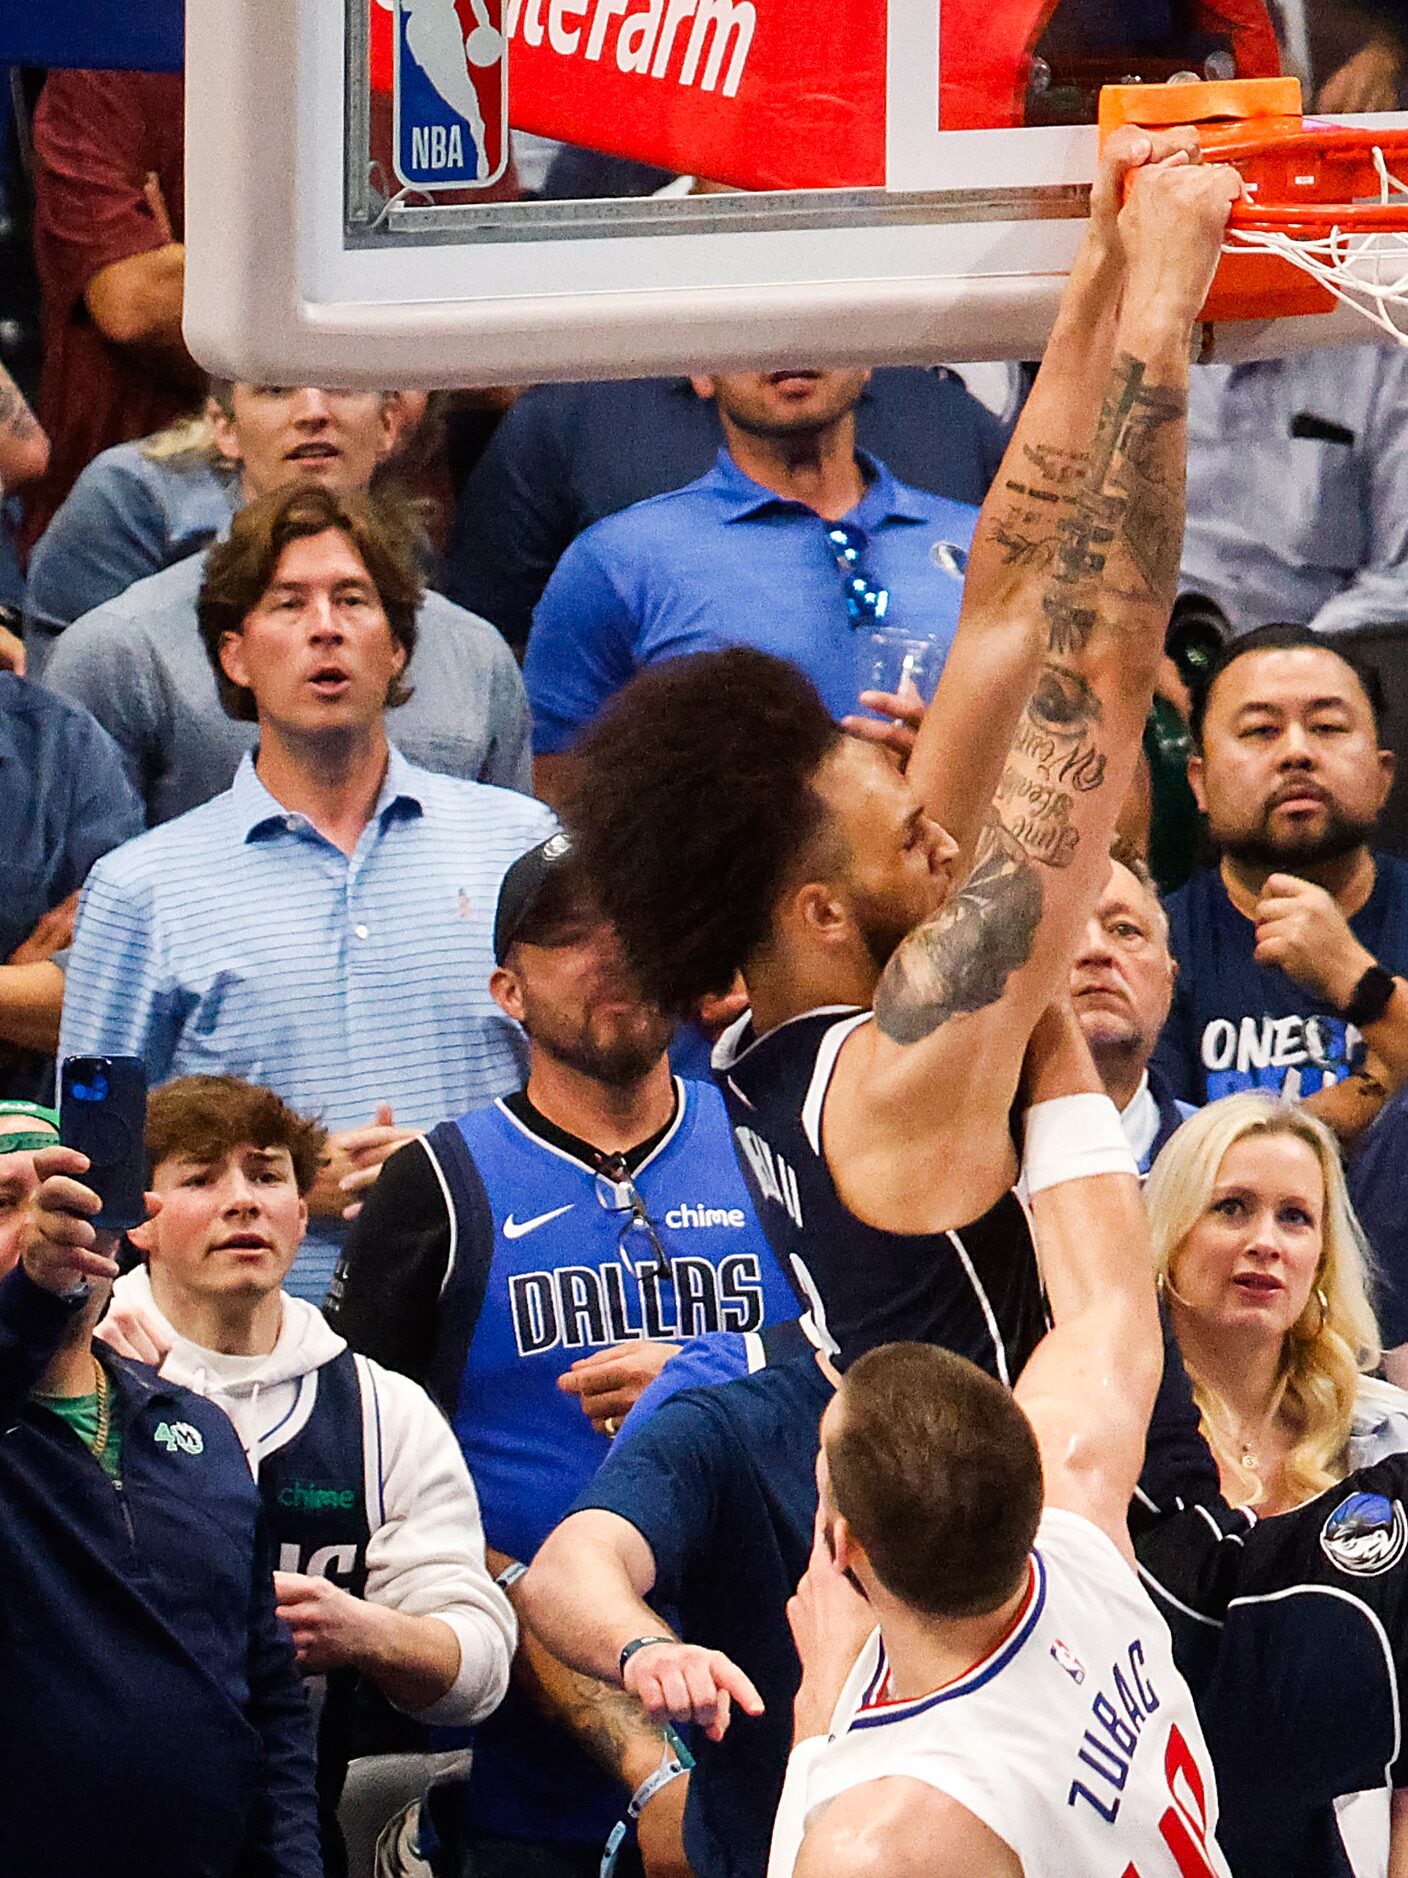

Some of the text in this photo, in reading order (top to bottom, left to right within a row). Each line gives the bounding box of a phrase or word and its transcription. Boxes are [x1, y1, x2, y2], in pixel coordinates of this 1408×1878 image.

[411, 124, 464, 170] NBA
[665, 1203, 745, 1228] chime
[508, 1253, 765, 1357] DALLAS
[279, 1481, 355, 1509] chime
[1068, 1639, 1160, 1824] ZUBAC
